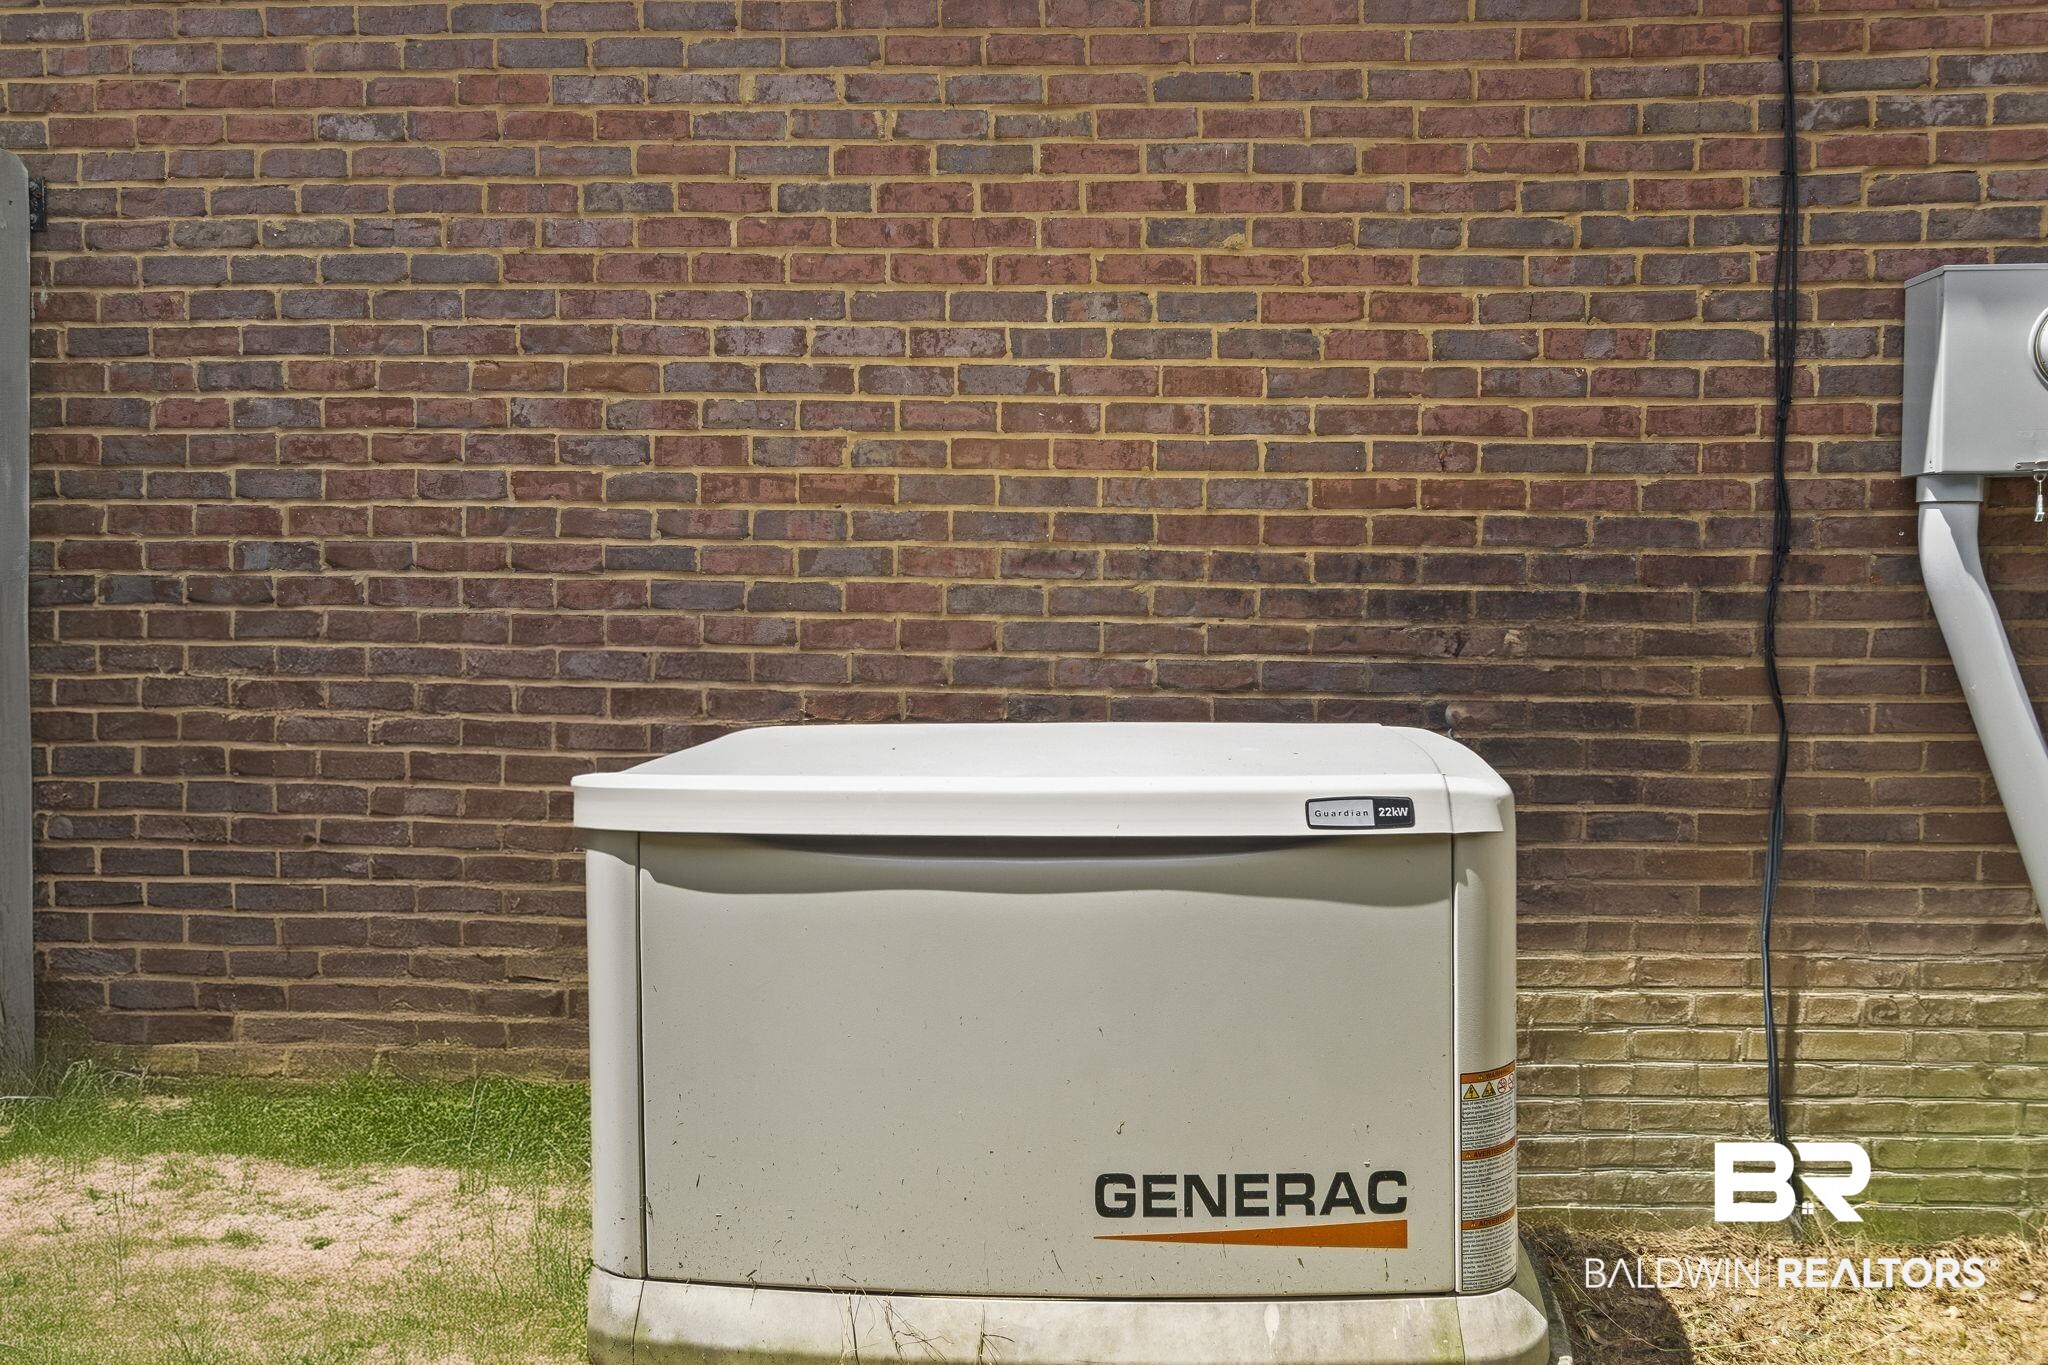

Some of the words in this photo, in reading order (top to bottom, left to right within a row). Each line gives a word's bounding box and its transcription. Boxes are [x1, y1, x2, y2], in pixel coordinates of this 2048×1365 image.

[1314, 809, 1369, 818] Guardian
[1378, 807, 1409, 817] 22kW
[1095, 1170, 1408, 1218] GENERAC
